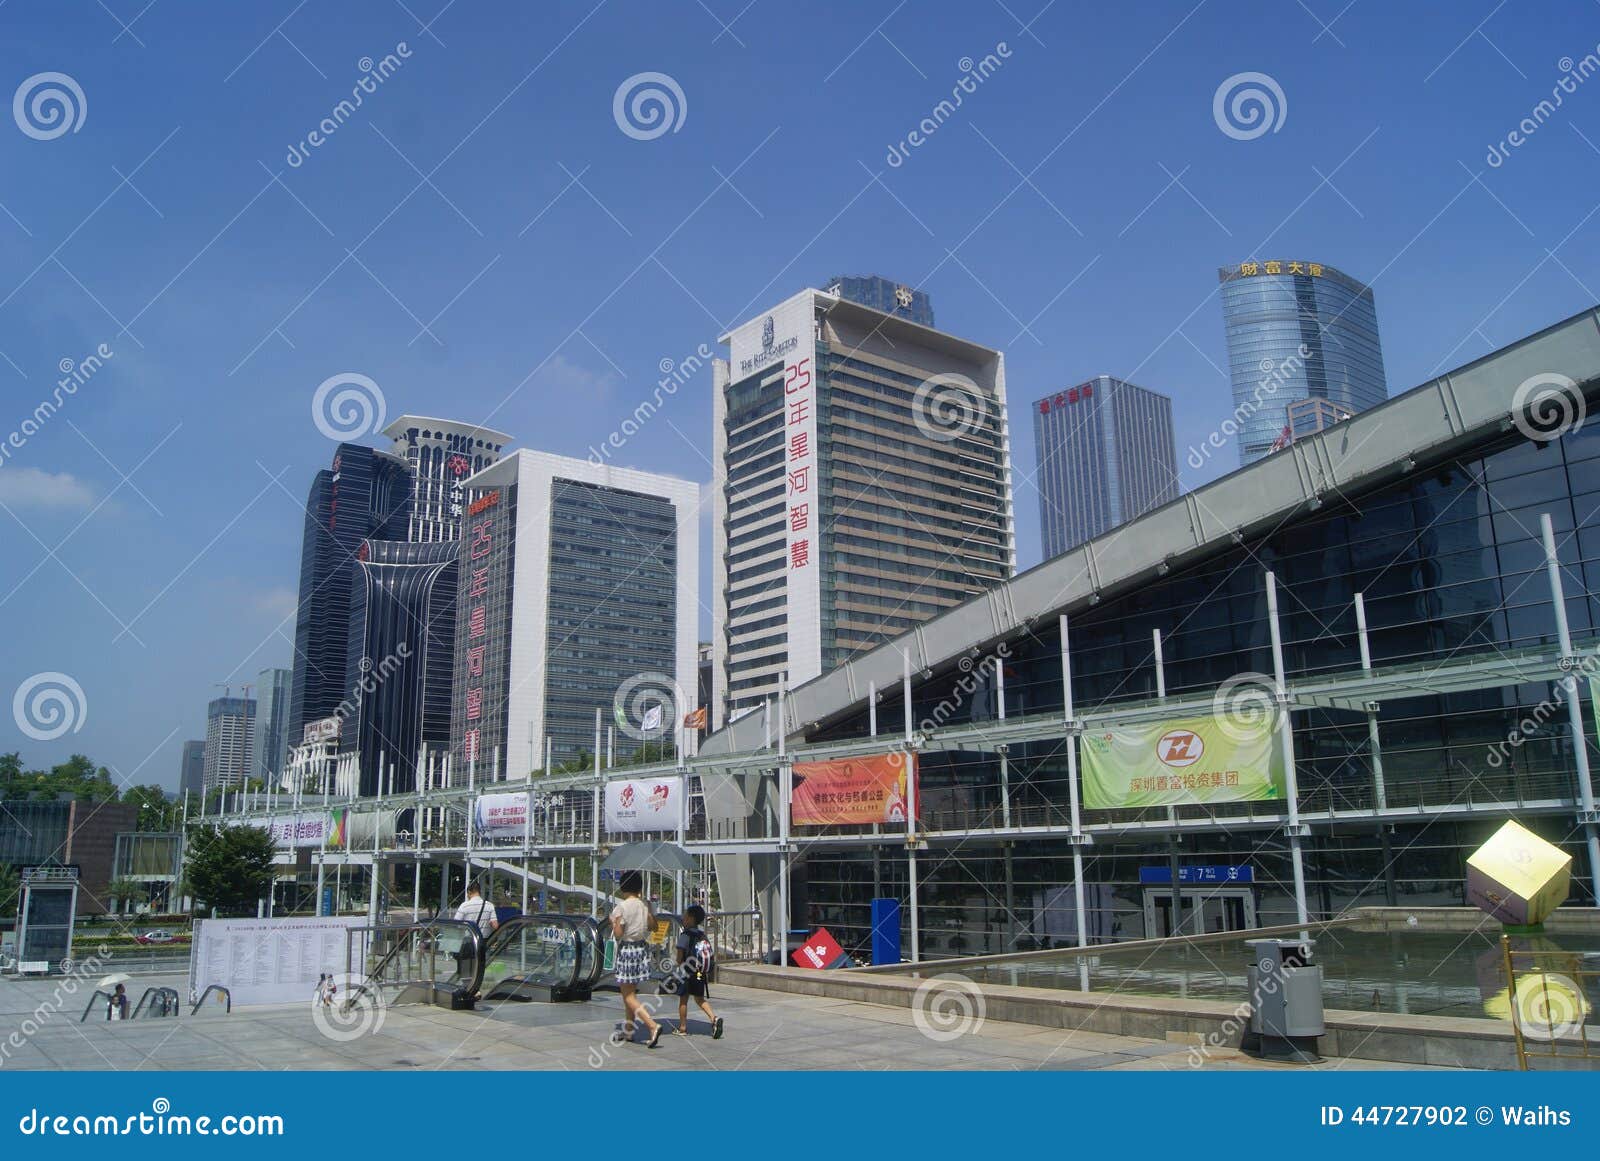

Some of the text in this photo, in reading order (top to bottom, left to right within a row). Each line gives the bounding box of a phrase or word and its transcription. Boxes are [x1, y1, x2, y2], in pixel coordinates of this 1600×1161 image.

[1241, 261, 1322, 277] 财富大厦
[785, 357, 811, 570] 25年星河智慧
[451, 477, 463, 517] 大中华
[1130, 771, 1239, 792] 深圳置富投资集团
